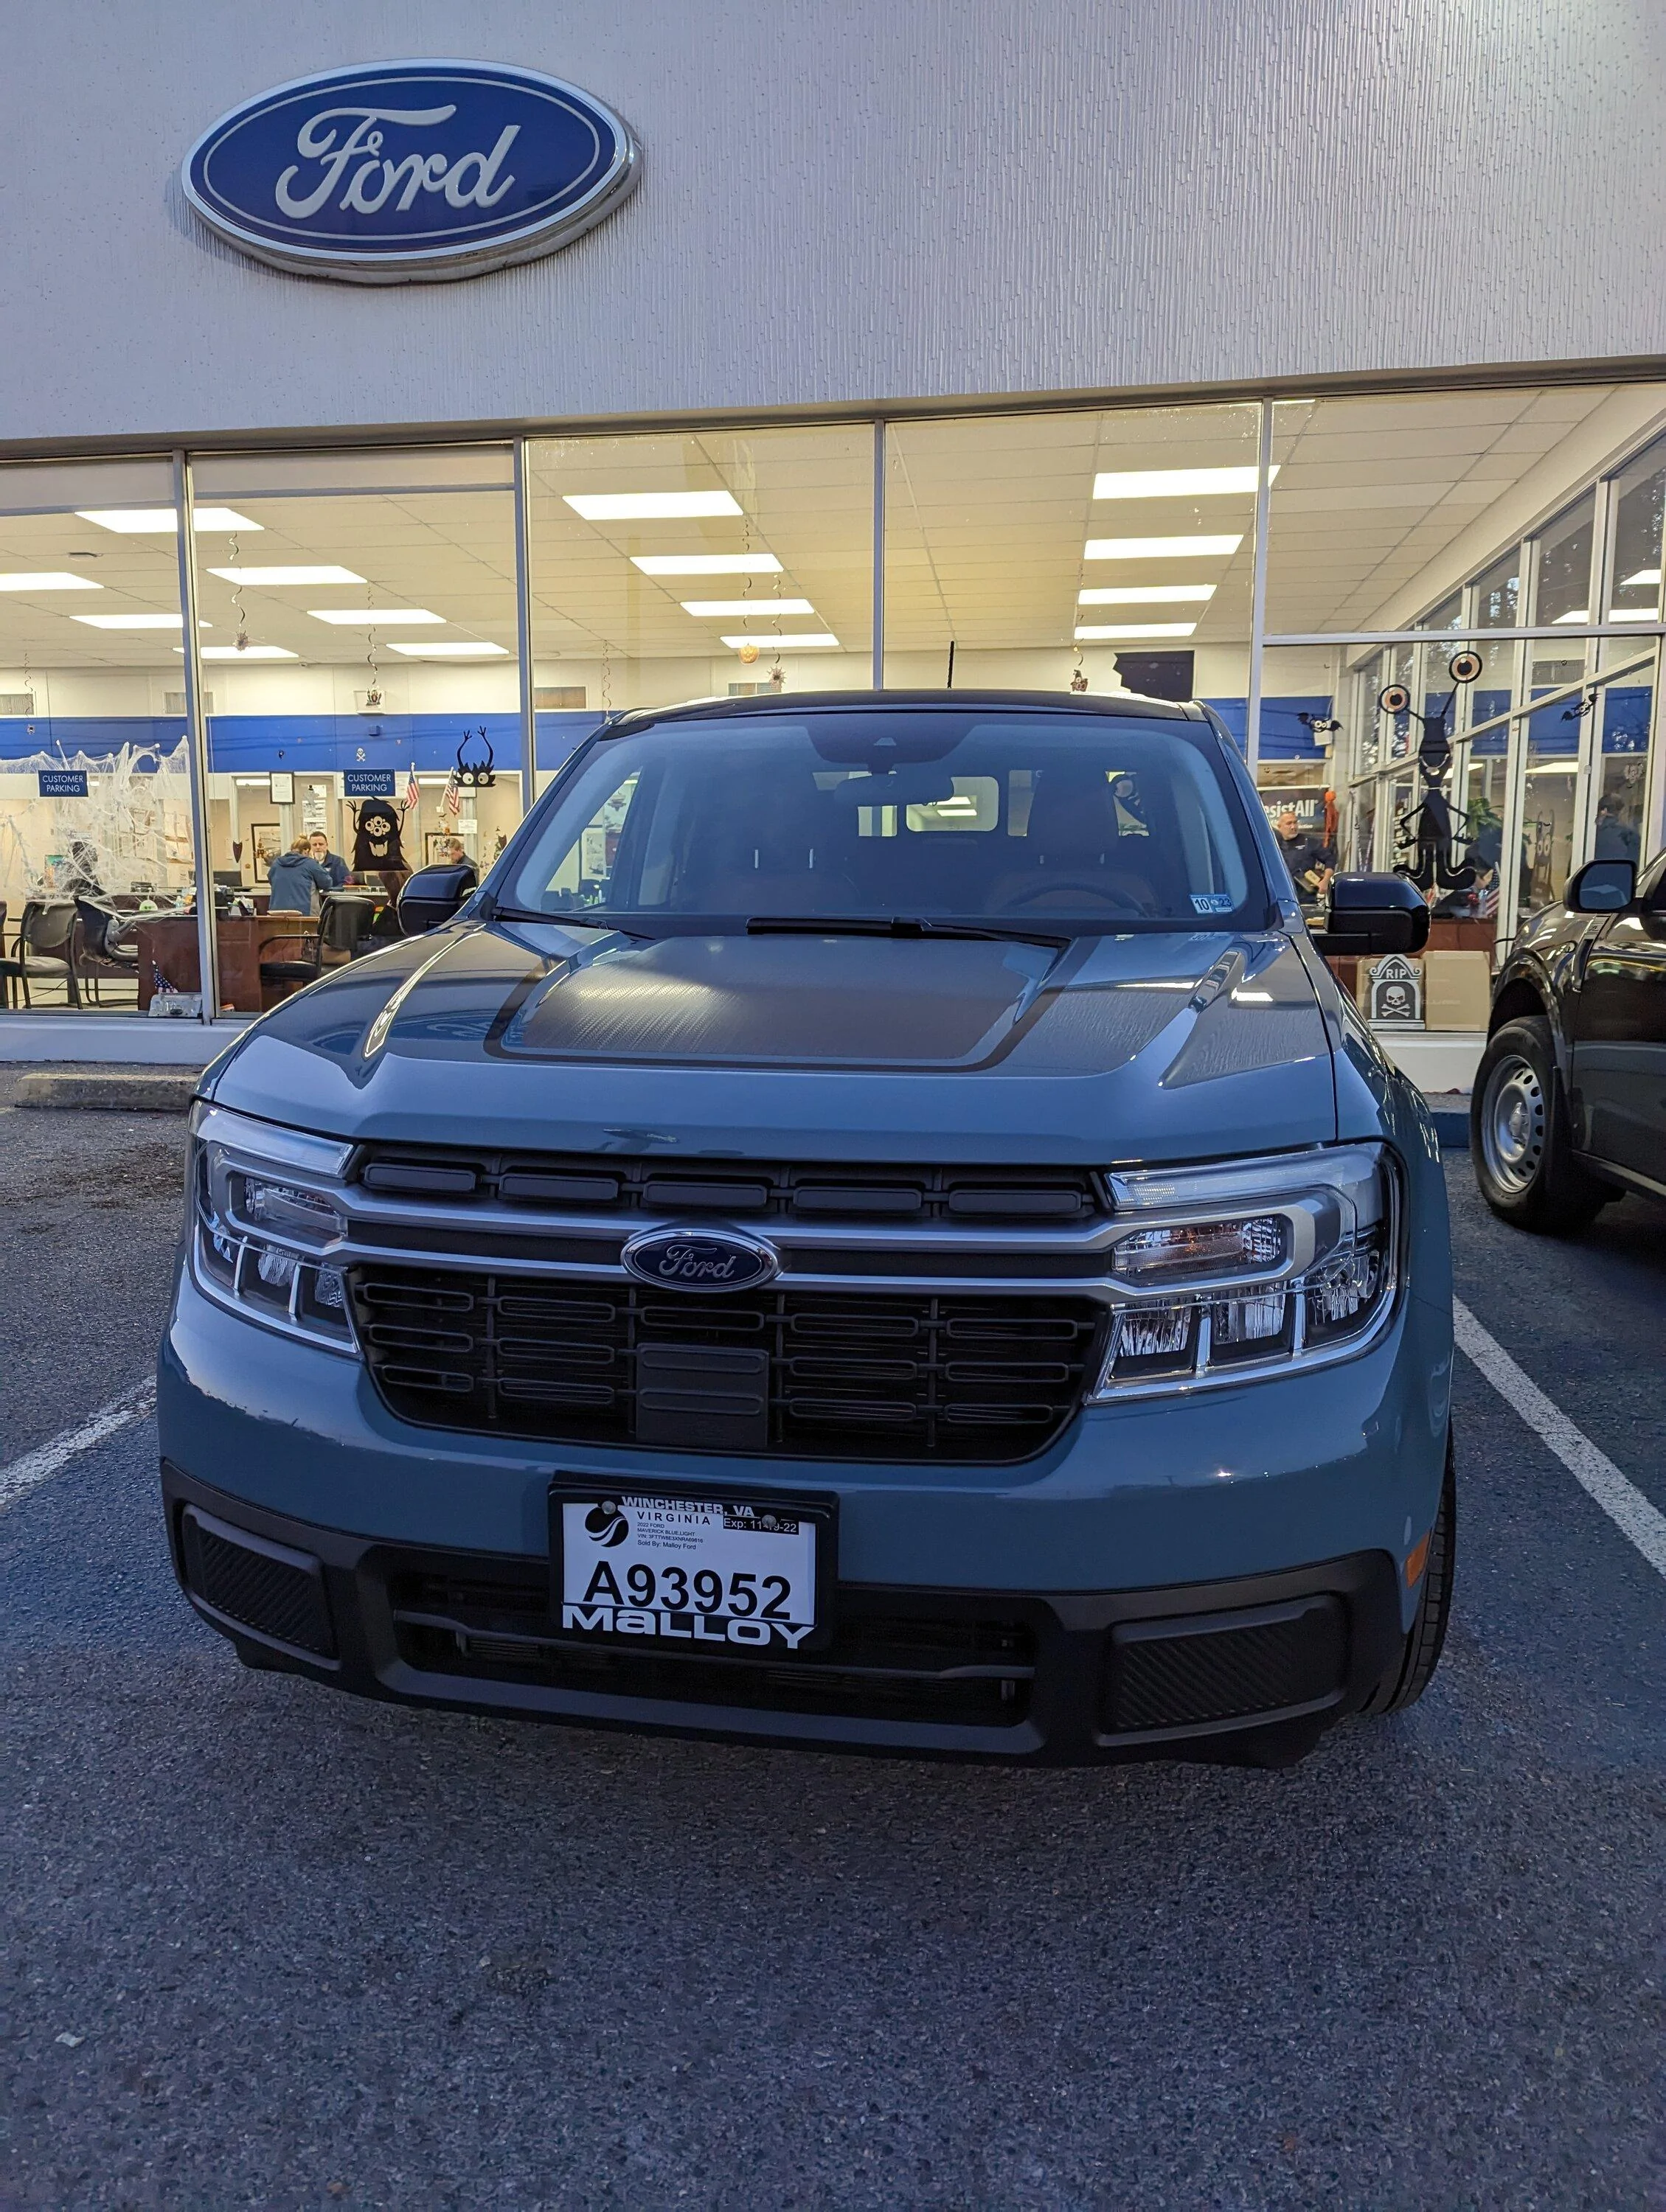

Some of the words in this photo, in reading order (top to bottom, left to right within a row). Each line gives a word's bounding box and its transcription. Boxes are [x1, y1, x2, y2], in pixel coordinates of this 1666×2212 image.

[275, 104, 521, 219] Ford
[42, 775, 83, 783] CUSTOMER
[347, 773, 392, 782] CUSTOMER
[46, 785, 80, 793] PARKING
[1195, 899, 1209, 911] 10
[1219, 897, 1232, 907] 23
[1386, 968, 1407, 979] RIP
[659, 1244, 737, 1279] Ford
[622, 1496, 728, 1516] WINCHESTER,
[733, 1505, 755, 1517] VA
[637, 1511, 711, 1526] VIRGINIA
[723, 1517, 746, 1529] Exp:
[662, 1542, 681, 1550] Malloy
[583, 1560, 791, 1621] A93952
